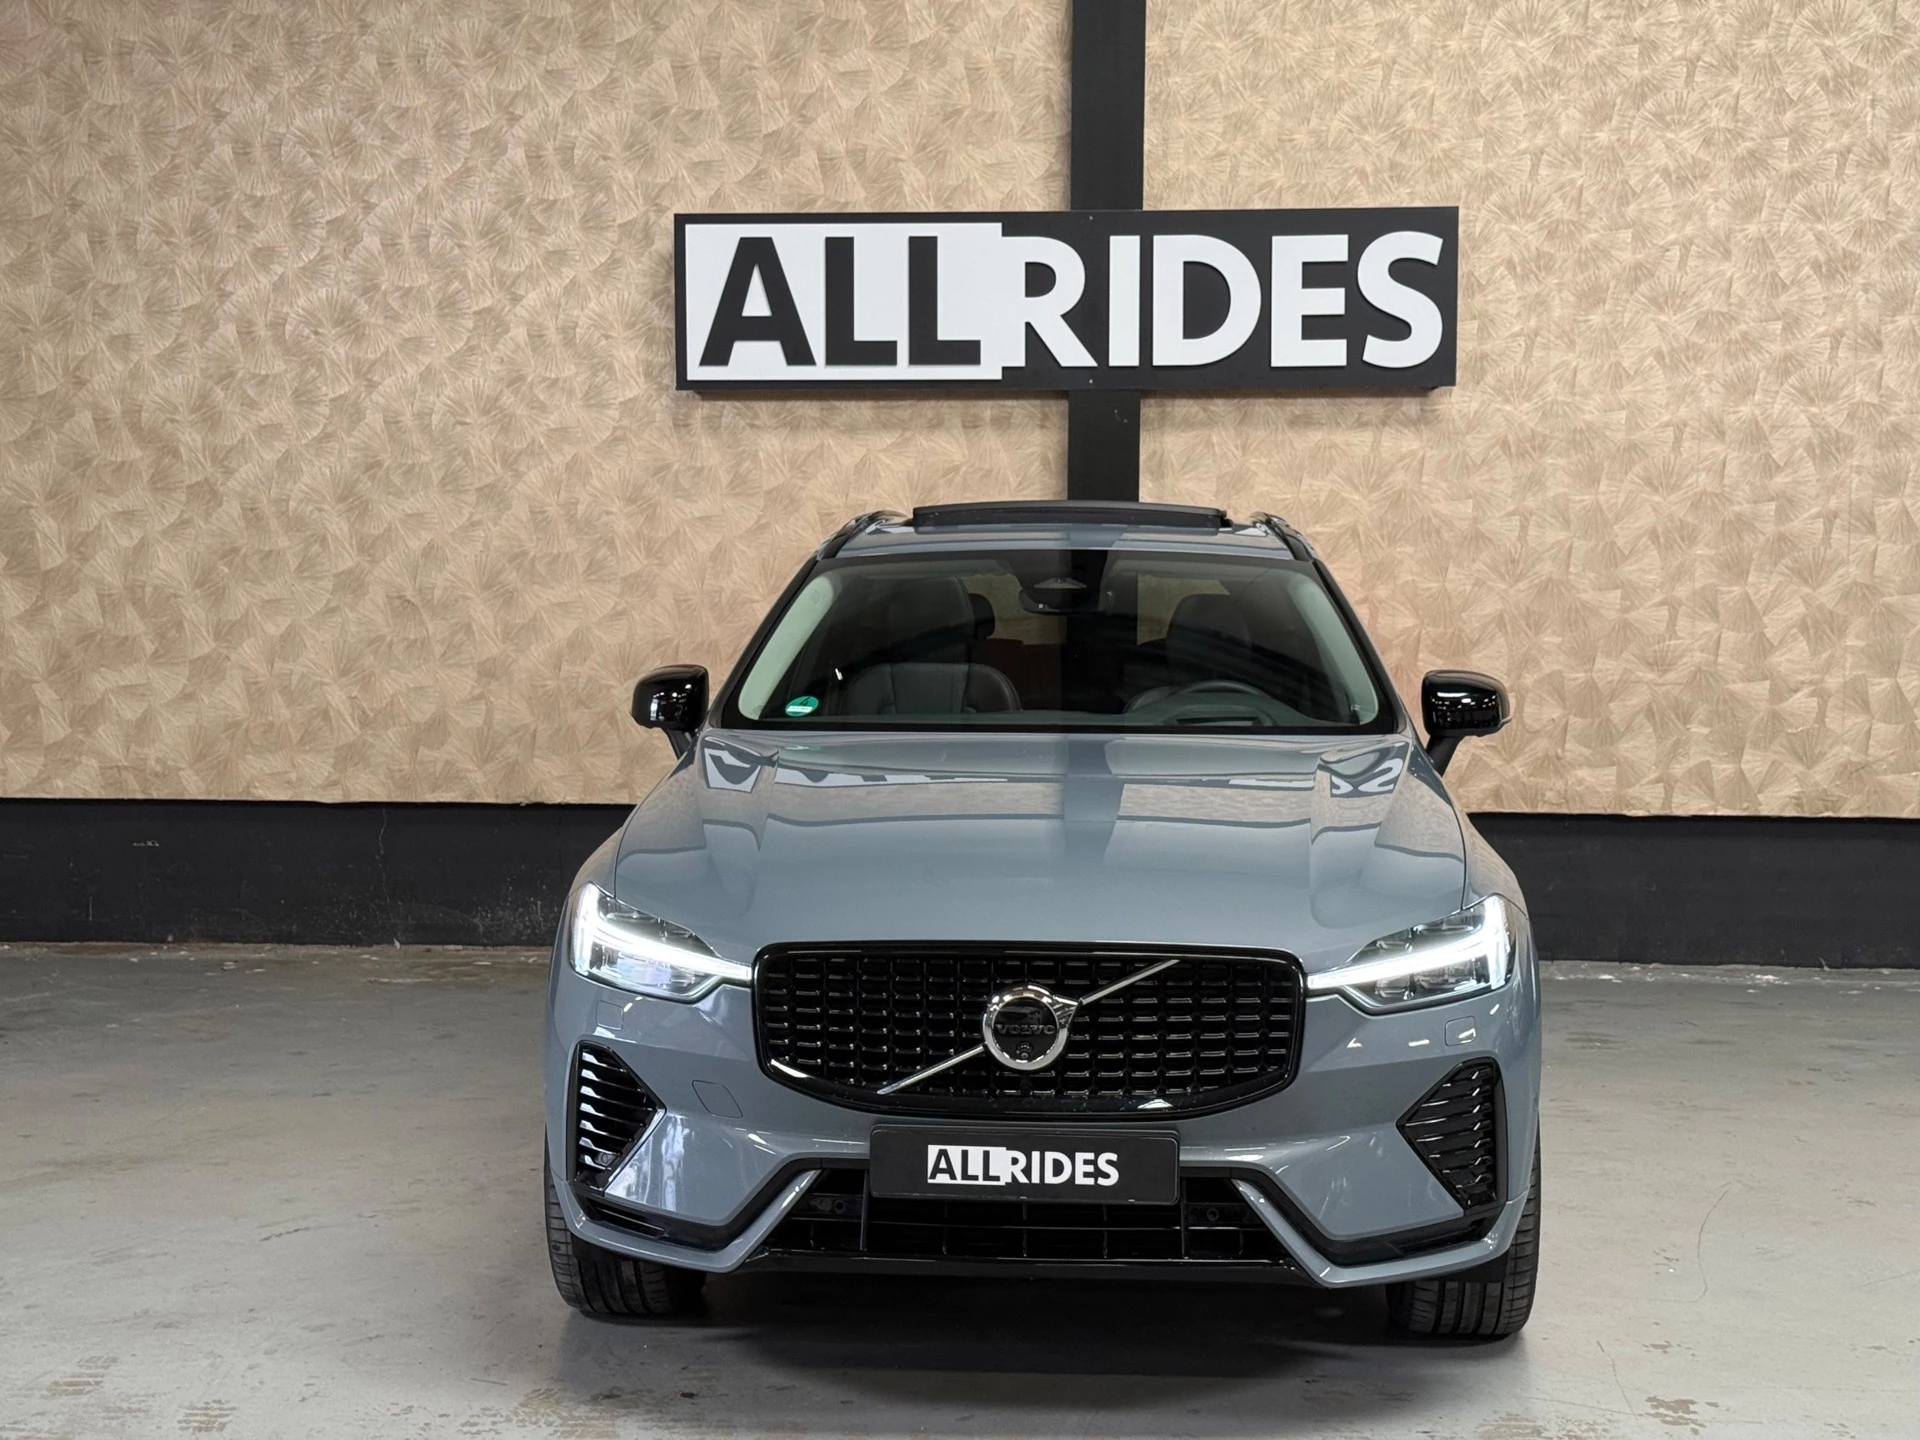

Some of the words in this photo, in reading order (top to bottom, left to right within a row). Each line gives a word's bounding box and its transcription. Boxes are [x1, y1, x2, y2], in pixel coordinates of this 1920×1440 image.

[699, 231, 1444, 368] ALLRIDES
[995, 1024, 1056, 1035] VOLVO
[929, 1148, 1119, 1186] ALLRIDES
